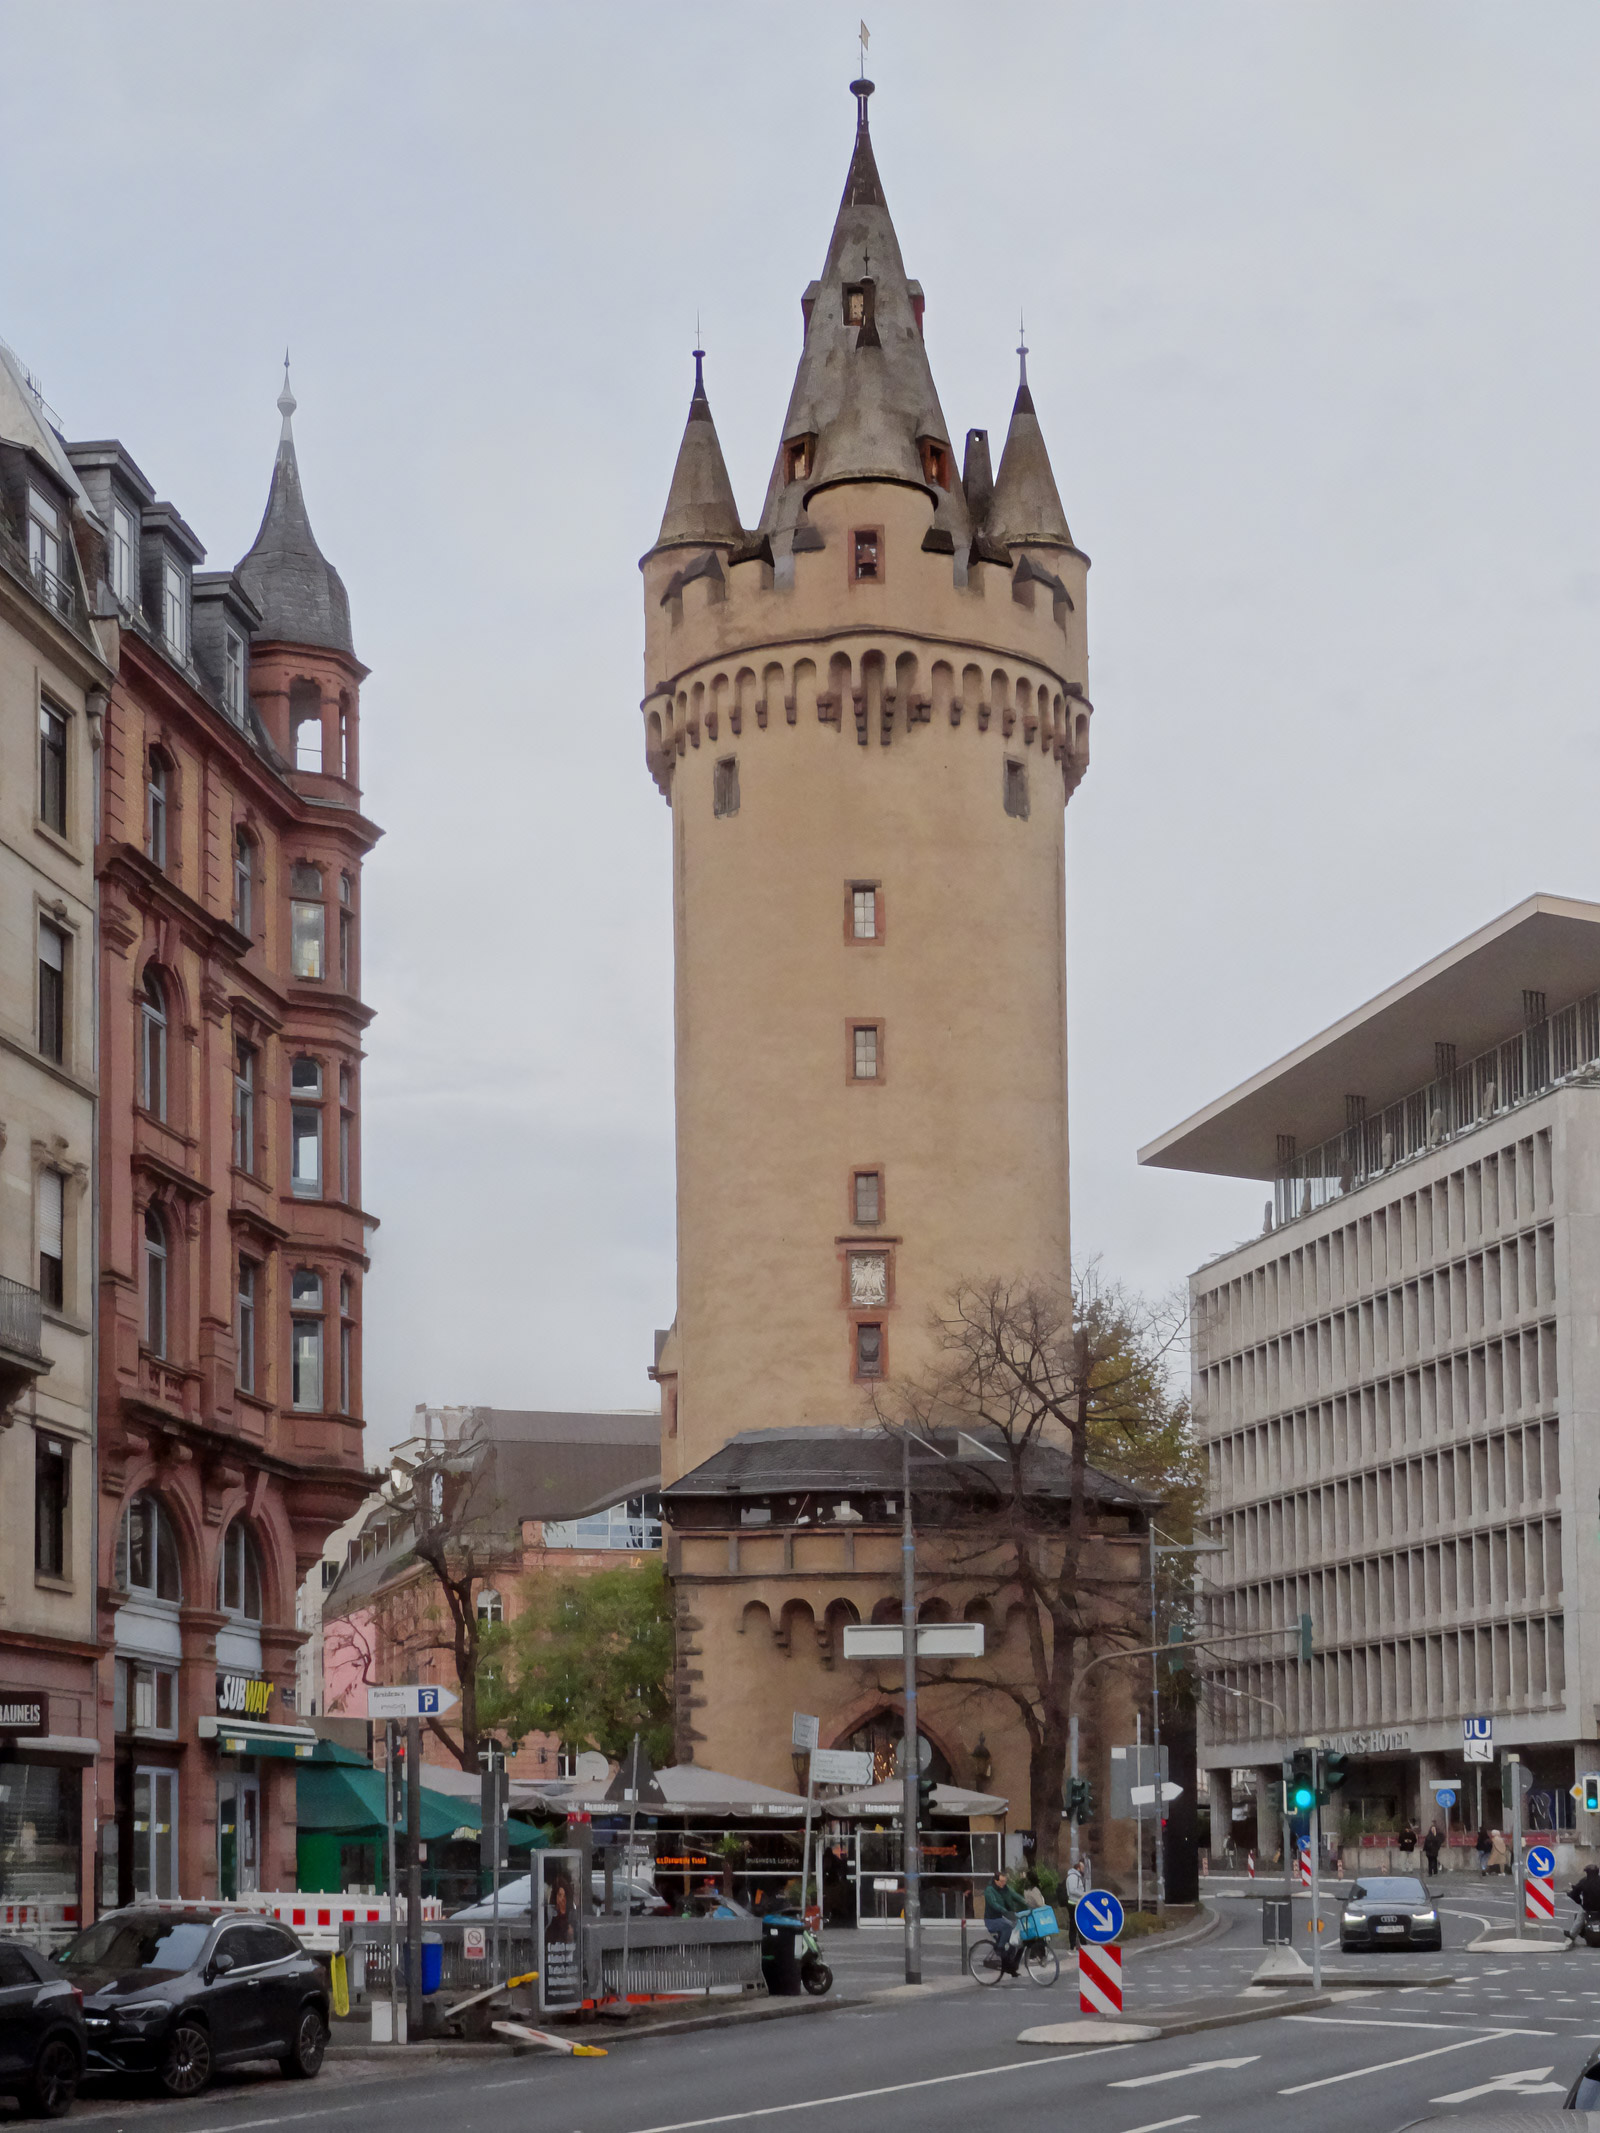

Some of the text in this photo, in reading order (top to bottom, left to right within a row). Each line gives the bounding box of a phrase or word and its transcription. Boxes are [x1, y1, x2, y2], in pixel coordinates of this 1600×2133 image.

[219, 1675, 274, 1714] SUBWAY
[424, 1695, 433, 1711] P
[1464, 1719, 1473, 1738] U
[1474, 1719, 1491, 1738] U
